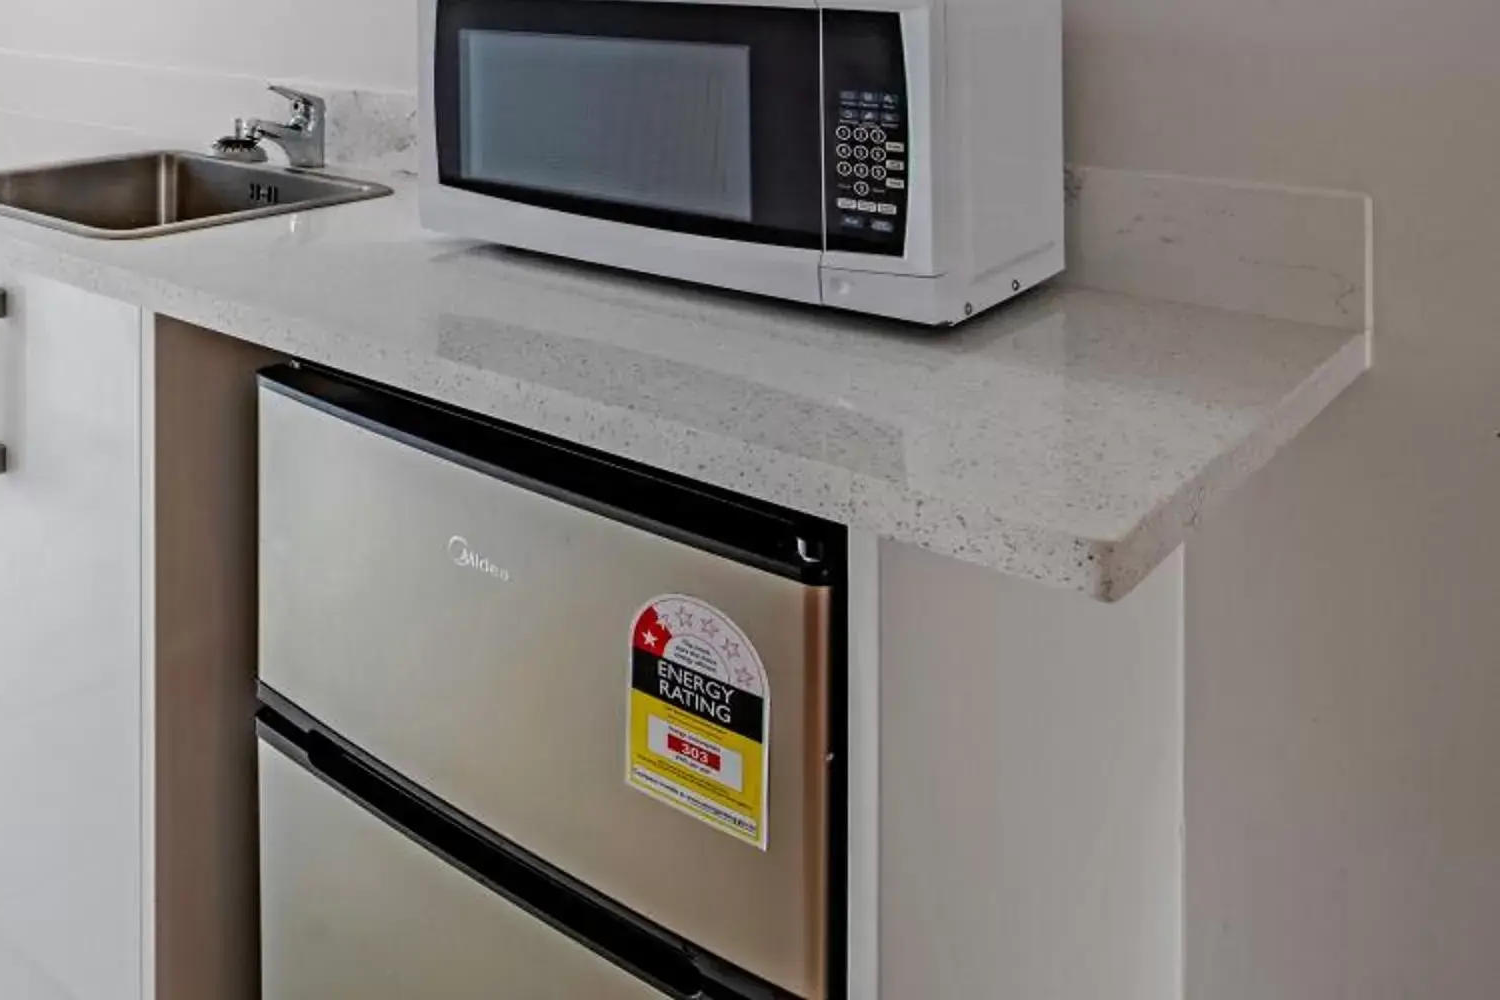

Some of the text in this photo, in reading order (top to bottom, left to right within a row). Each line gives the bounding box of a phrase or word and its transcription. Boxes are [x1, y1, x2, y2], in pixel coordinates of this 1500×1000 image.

[657, 660, 735, 704] ENERGY
[659, 679, 732, 723] RATING
[680, 742, 709, 764] 303
